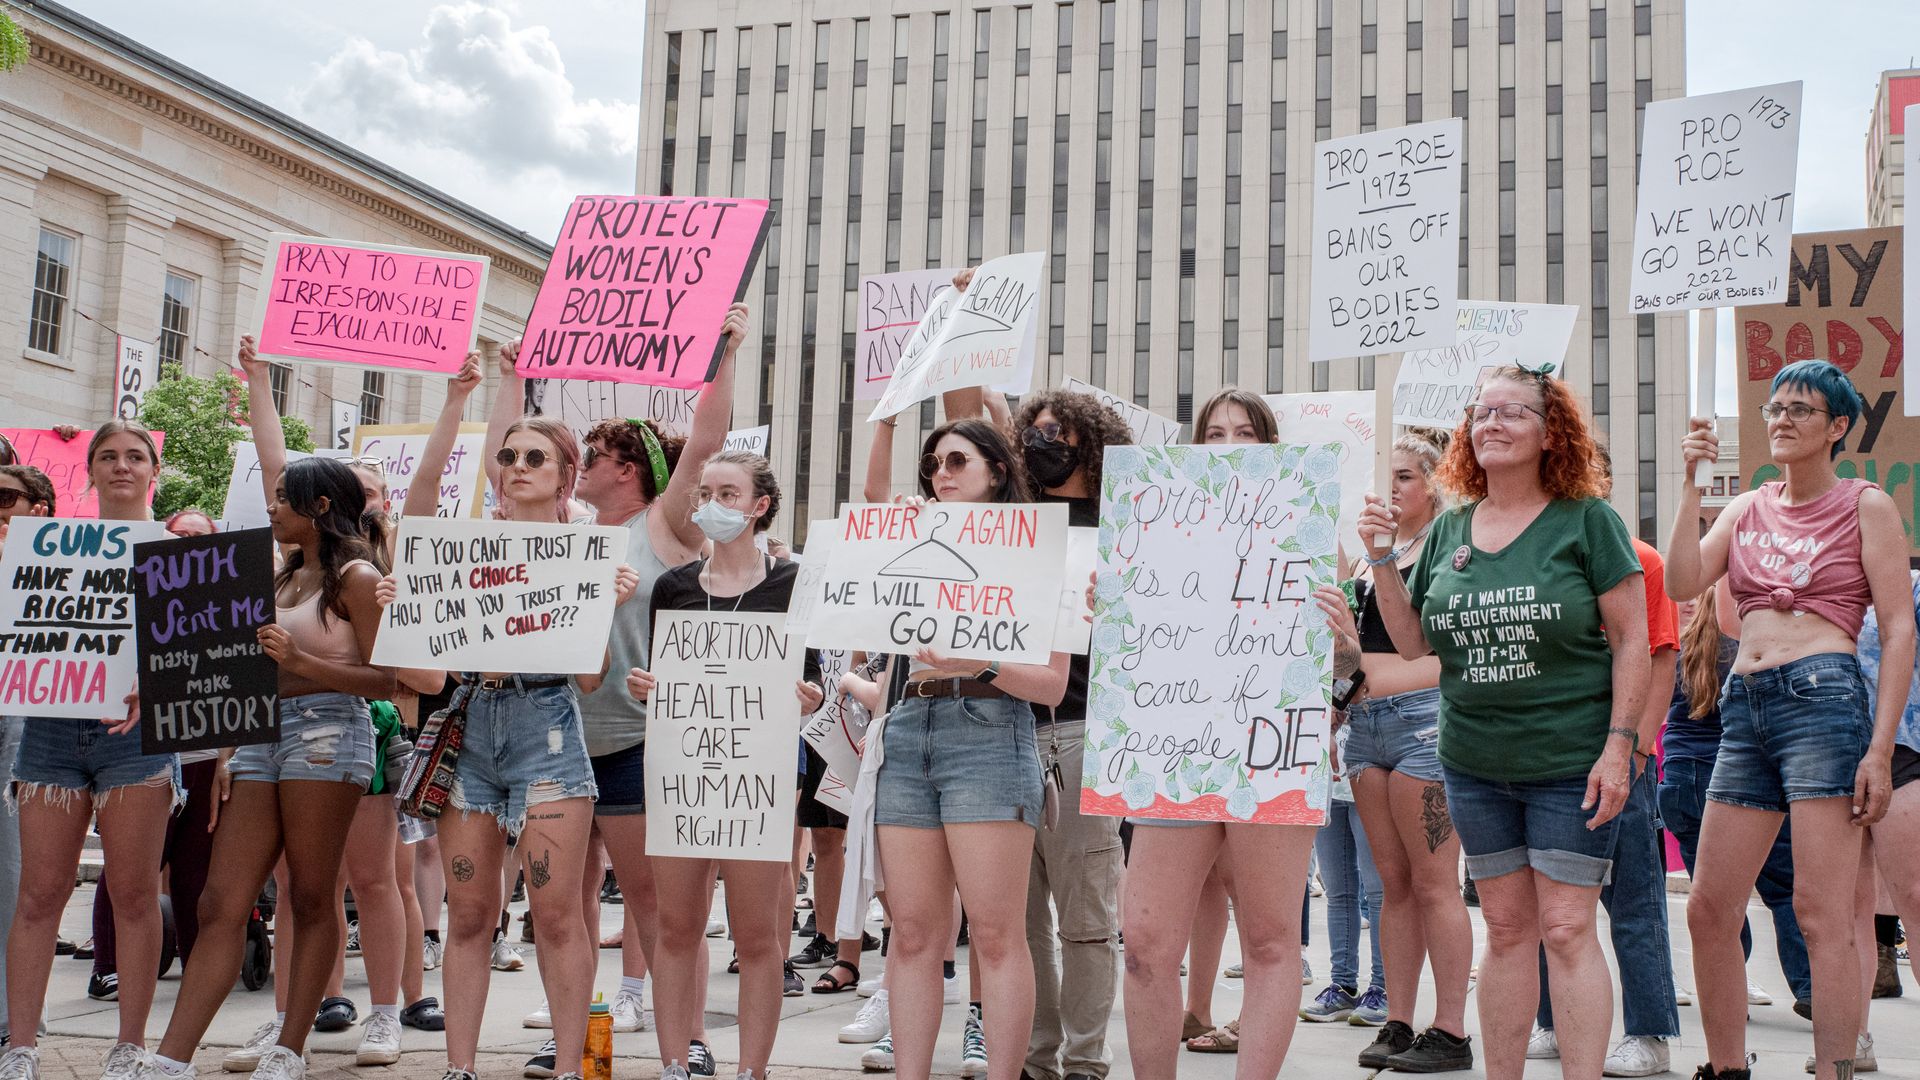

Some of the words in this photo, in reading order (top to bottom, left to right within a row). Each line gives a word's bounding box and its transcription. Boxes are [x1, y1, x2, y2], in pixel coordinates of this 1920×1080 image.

[1748, 95, 1791, 129] 1973
[1681, 113, 1742, 151] PRO
[1674, 148, 1744, 186] ROE
[1362, 171, 1411, 204] 1973
[568, 198, 738, 239] PROTECT
[1651, 208, 1693, 237] WE
[1709, 192, 1792, 232] WON'T
[1328, 223, 1393, 259] BANS
[1410, 212, 1450, 242] OFF
[1641, 245, 1679, 275] GO
[1698, 231, 1773, 266] BACK
[286, 245, 350, 279] PRAY
[367, 254, 396, 281] TO
[415, 261, 474, 290] END
[564, 245, 711, 285] WOMEN'S
[1358, 255, 1409, 287] OUR
[1687, 267, 1738, 289] 2022
[1785, 239, 1888, 306] MY
[275, 278, 467, 322] IRRESPONSIBLE
[559, 288, 687, 330] BODILY
[1329, 286, 1440, 327] BODIES
[1634, 294, 1661, 310] BANS
[1666, 290, 1691, 305] OFF
[1698, 288, 1721, 301] OUR
[290, 310, 447, 350] EJACULATION.
[1360, 316, 1426, 348] 2022
[1455, 308, 1528, 337] MEN'S
[126, 347, 143, 362] THE
[526, 328, 695, 378] AUTONOMY
[866, 329, 910, 383] MY
[971, 347, 1018, 370] WADE
[1745, 317, 1903, 381] BODY
[1300, 402, 1332, 420] YOUR
[724, 435, 762, 451] MIND
[33, 522, 130, 560] GUNS
[844, 507, 919, 541] NEVER
[957, 509, 1037, 548] AGAIN
[1738, 530, 1825, 555] WOMAN
[405, 536, 423, 564] IF
[430, 537, 463, 565] YOU
[470, 533, 512, 563] CAN'T
[522, 534, 576, 562] TRUST
[584, 536, 610, 560] ME
[1760, 554, 1786, 571] UP
[12, 566, 73, 591] HAVE
[135, 543, 239, 598] RUTH
[407, 574, 442, 595] WITH
[451, 570, 462, 590] A
[469, 564, 529, 589] CHOICE,
[1123, 561, 1170, 598] is
[1182, 571, 1207, 602] a
[1231, 558, 1311, 604] LIE
[23, 594, 129, 620] RIGHTS
[390, 603, 421, 628] HOW
[435, 598, 466, 623] CAN
[476, 594, 503, 617] YOU
[515, 585, 564, 611] TRUST
[577, 583, 600, 600] ME
[823, 581, 859, 606] WE
[872, 581, 925, 608] WILL
[937, 582, 1016, 616] NEVER
[1449, 594, 1462, 610] IF
[1467, 593, 1472, 608] I
[1478, 585, 1535, 606] WANTED
[151, 598, 222, 645] Sent
[231, 596, 272, 628] Me
[890, 611, 938, 646] GO
[950, 615, 1030, 651] BACK
[1429, 613, 1455, 631] THE
[1460, 603, 1562, 627] GOVERNMENT
[1452, 630, 1469, 647] IN
[1472, 628, 1490, 645] MY
[1495, 624, 1540, 643] WOMB,
[0, 632, 69, 654] THAN
[74, 633, 127, 656] MY
[429, 628, 468, 657] WITH
[483, 624, 494, 642] A
[660, 621, 788, 661] ABORTION
[1122, 622, 1204, 671] you
[1215, 612, 1308, 657] don't
[1468, 648, 1485, 665] I'D
[150, 651, 198, 675] nasty
[1462, 668, 1468, 682] A
[1470, 661, 1541, 683] SENATOR.
[655, 682, 764, 721] HEALTH
[1134, 679, 1212, 708] care
[1223, 664, 1269, 724] if
[154, 694, 277, 741] HISTORY
[681, 727, 751, 759] CARE
[1107, 721, 1237, 784] people
[1245, 707, 1326, 772] DIE
[663, 774, 775, 809] HUMAN
